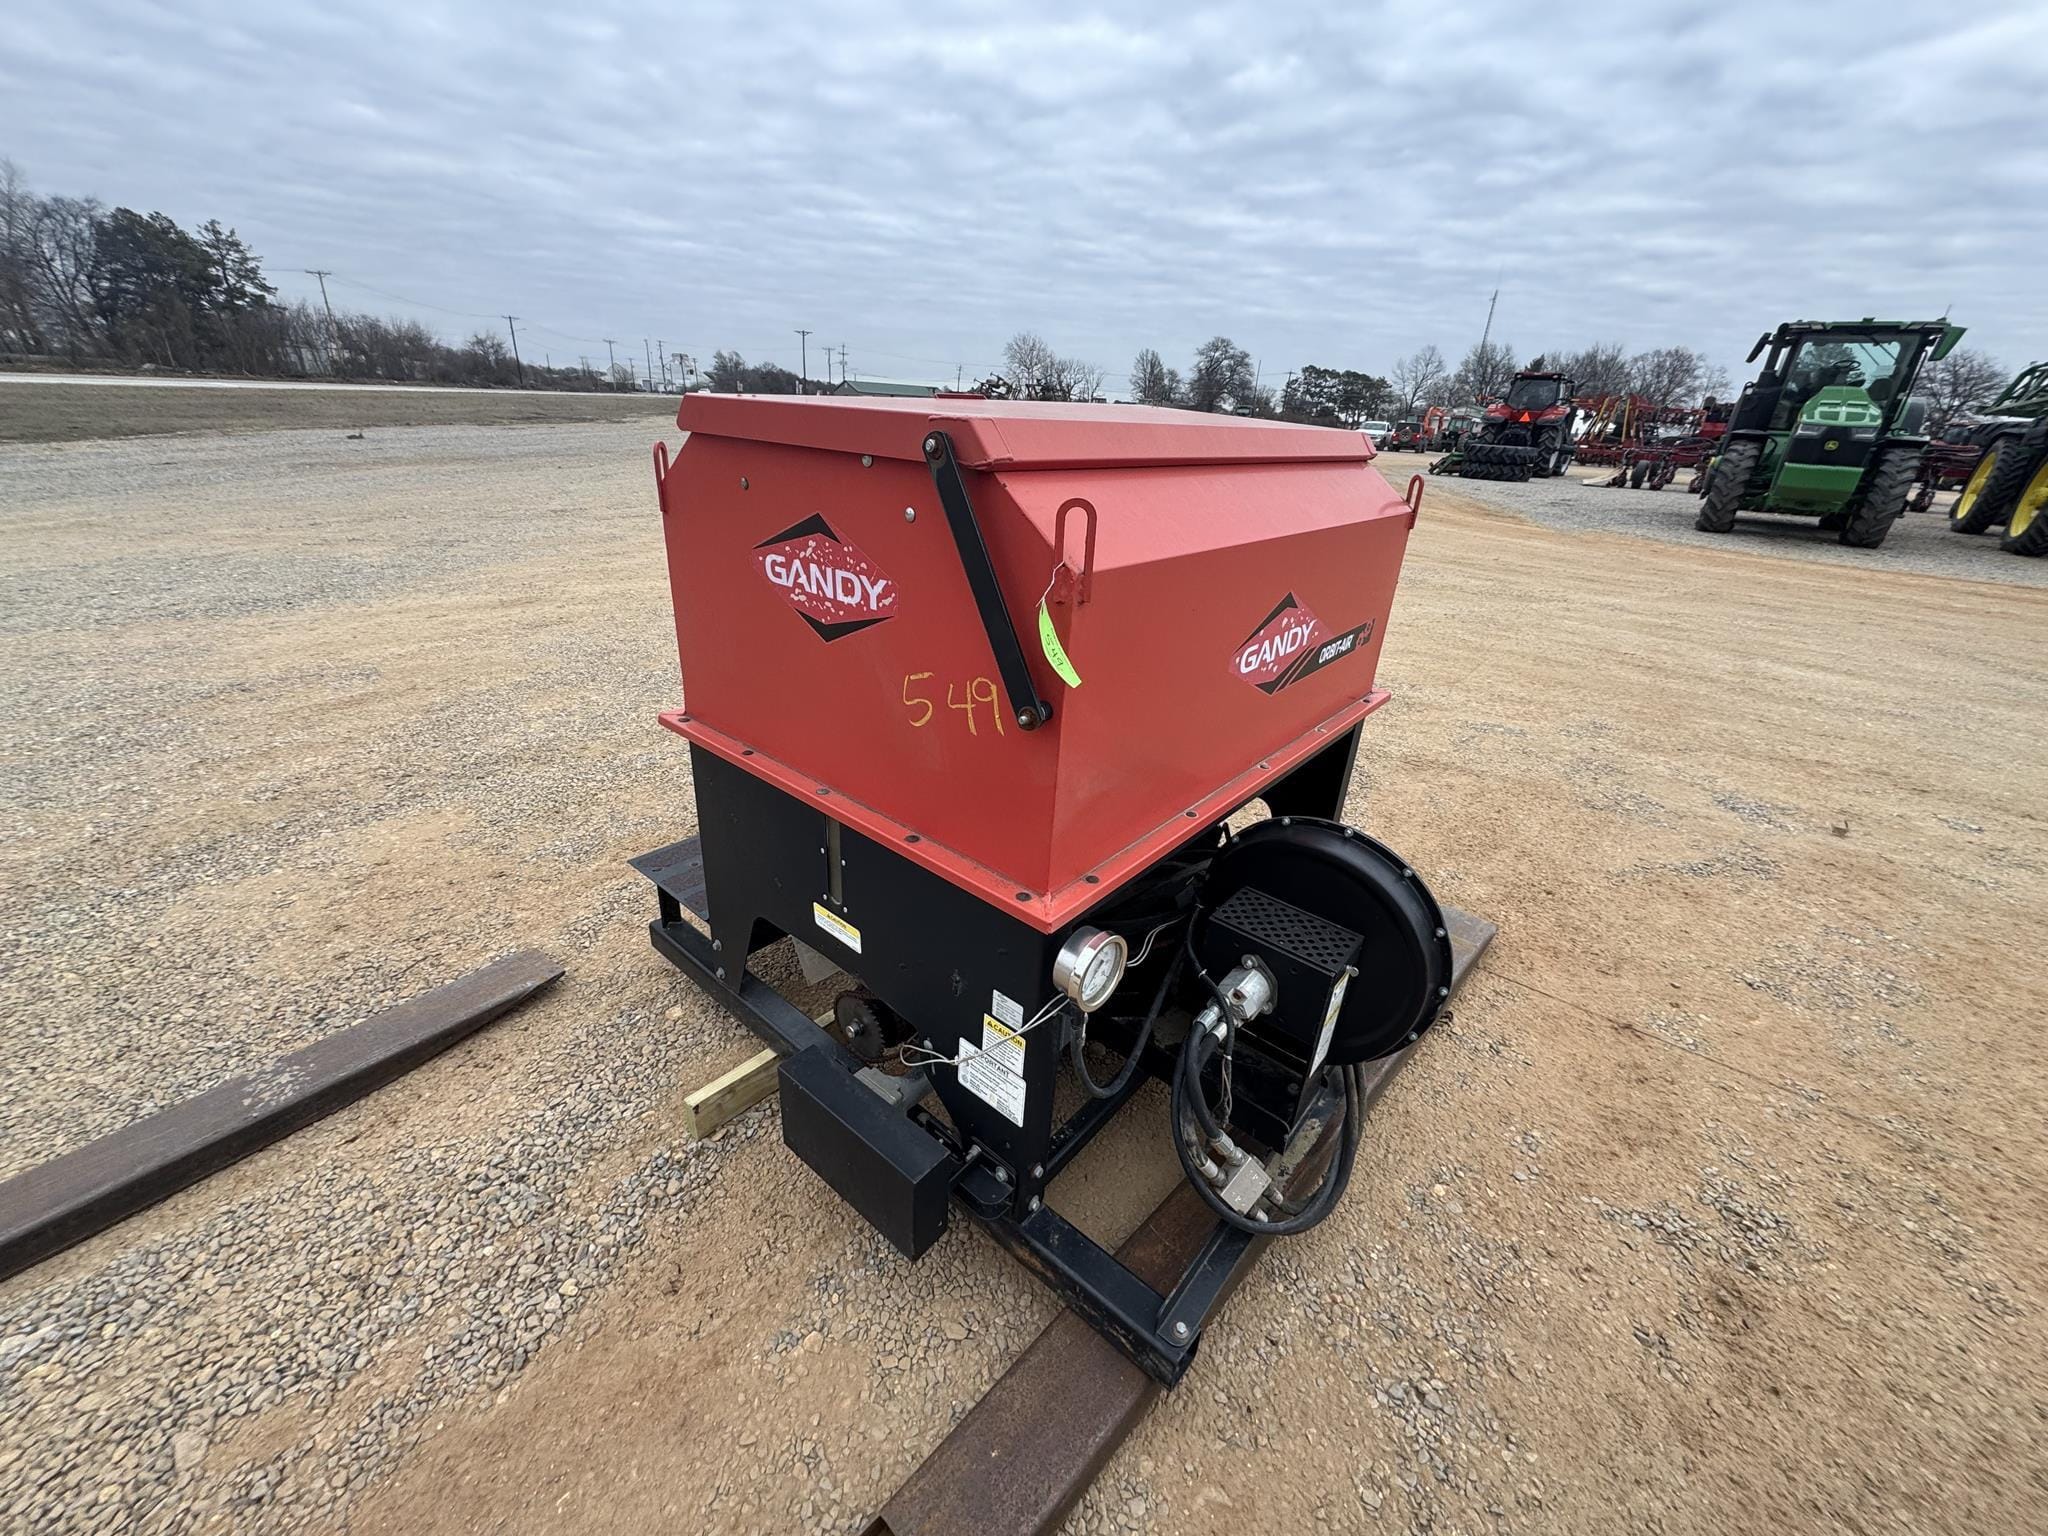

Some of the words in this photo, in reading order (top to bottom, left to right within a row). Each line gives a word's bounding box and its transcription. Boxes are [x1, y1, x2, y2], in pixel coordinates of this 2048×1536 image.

[765, 553, 887, 610] GANDY
[1240, 619, 1318, 674] GANDY
[993, 1024, 1023, 1047] CAUON
